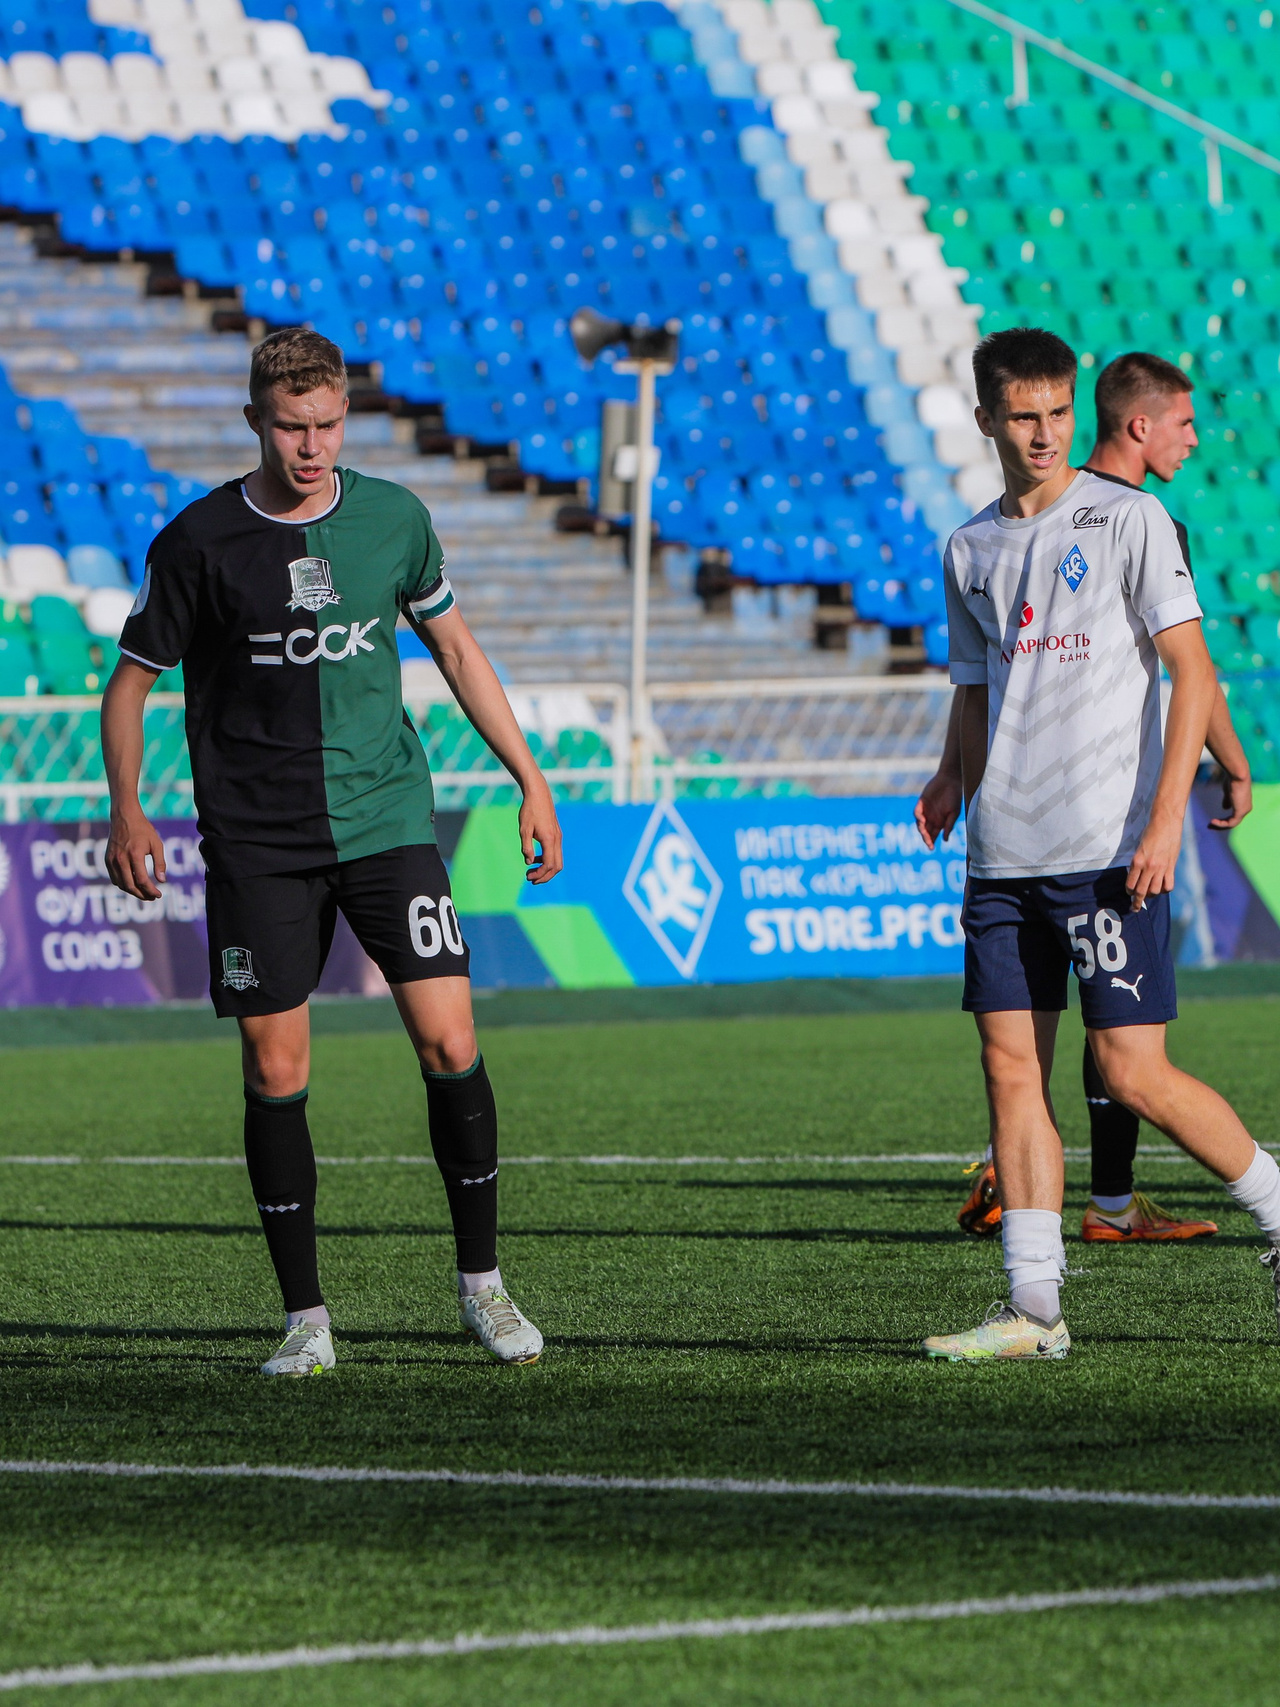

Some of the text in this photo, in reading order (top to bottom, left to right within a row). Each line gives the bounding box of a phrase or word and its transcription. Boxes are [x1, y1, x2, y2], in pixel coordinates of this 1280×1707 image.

[1059, 651, 1091, 664] БАНК
[42, 929, 144, 972] СОЮЗ
[408, 895, 465, 958] 60
[1067, 908, 1128, 979] 58
